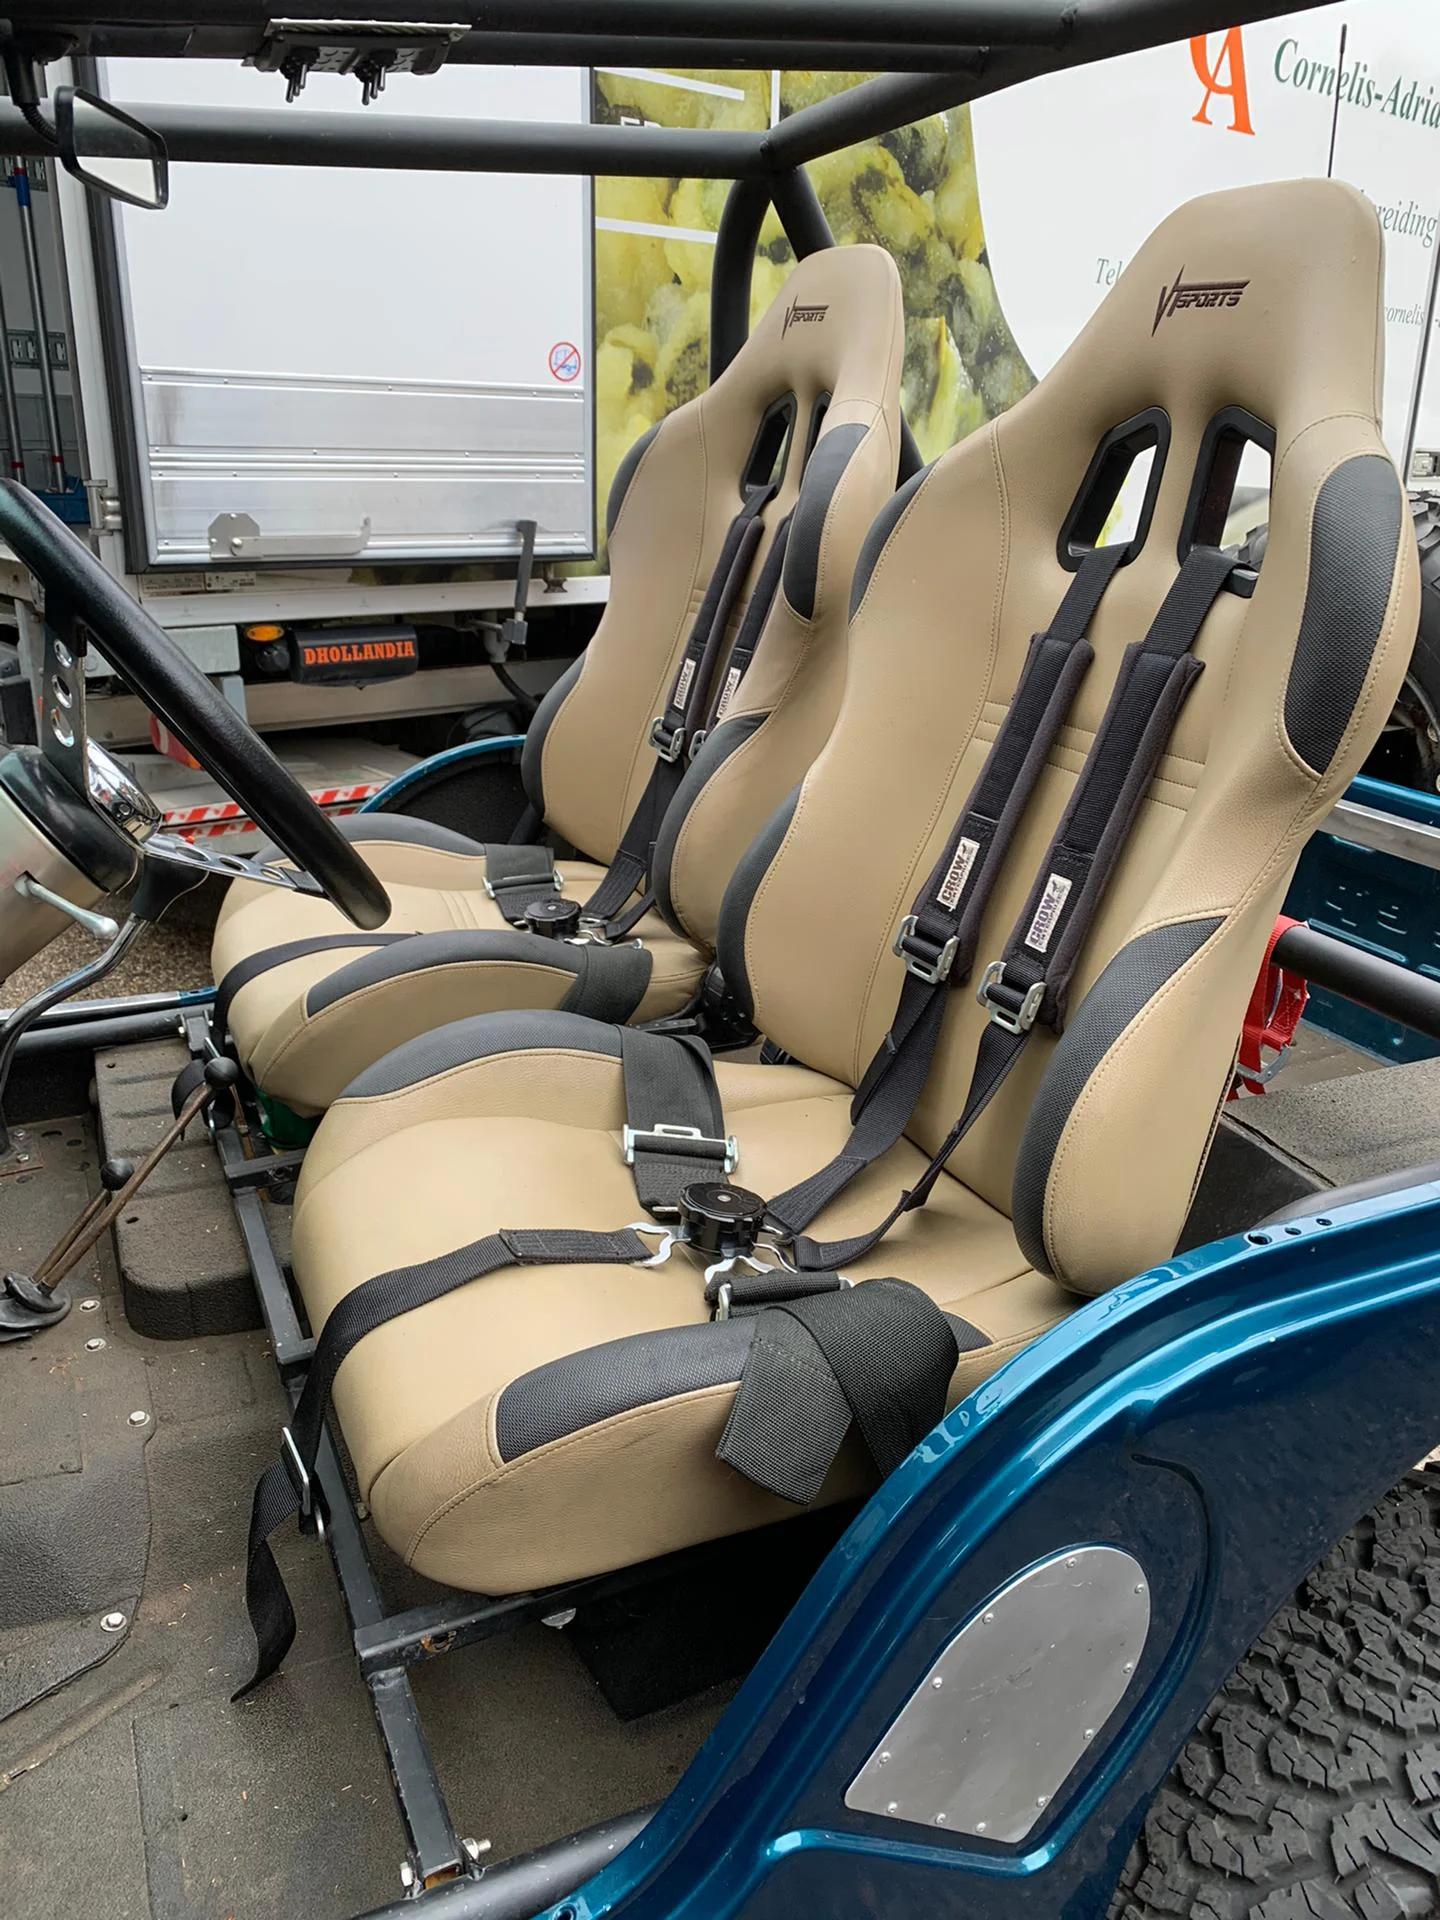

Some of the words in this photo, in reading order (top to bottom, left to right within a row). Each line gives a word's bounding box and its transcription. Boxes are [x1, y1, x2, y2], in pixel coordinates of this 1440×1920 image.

[303, 640, 416, 665] DHOLLANDIA
[941, 854, 966, 901] CROW
[1030, 892, 1056, 945] CROW
